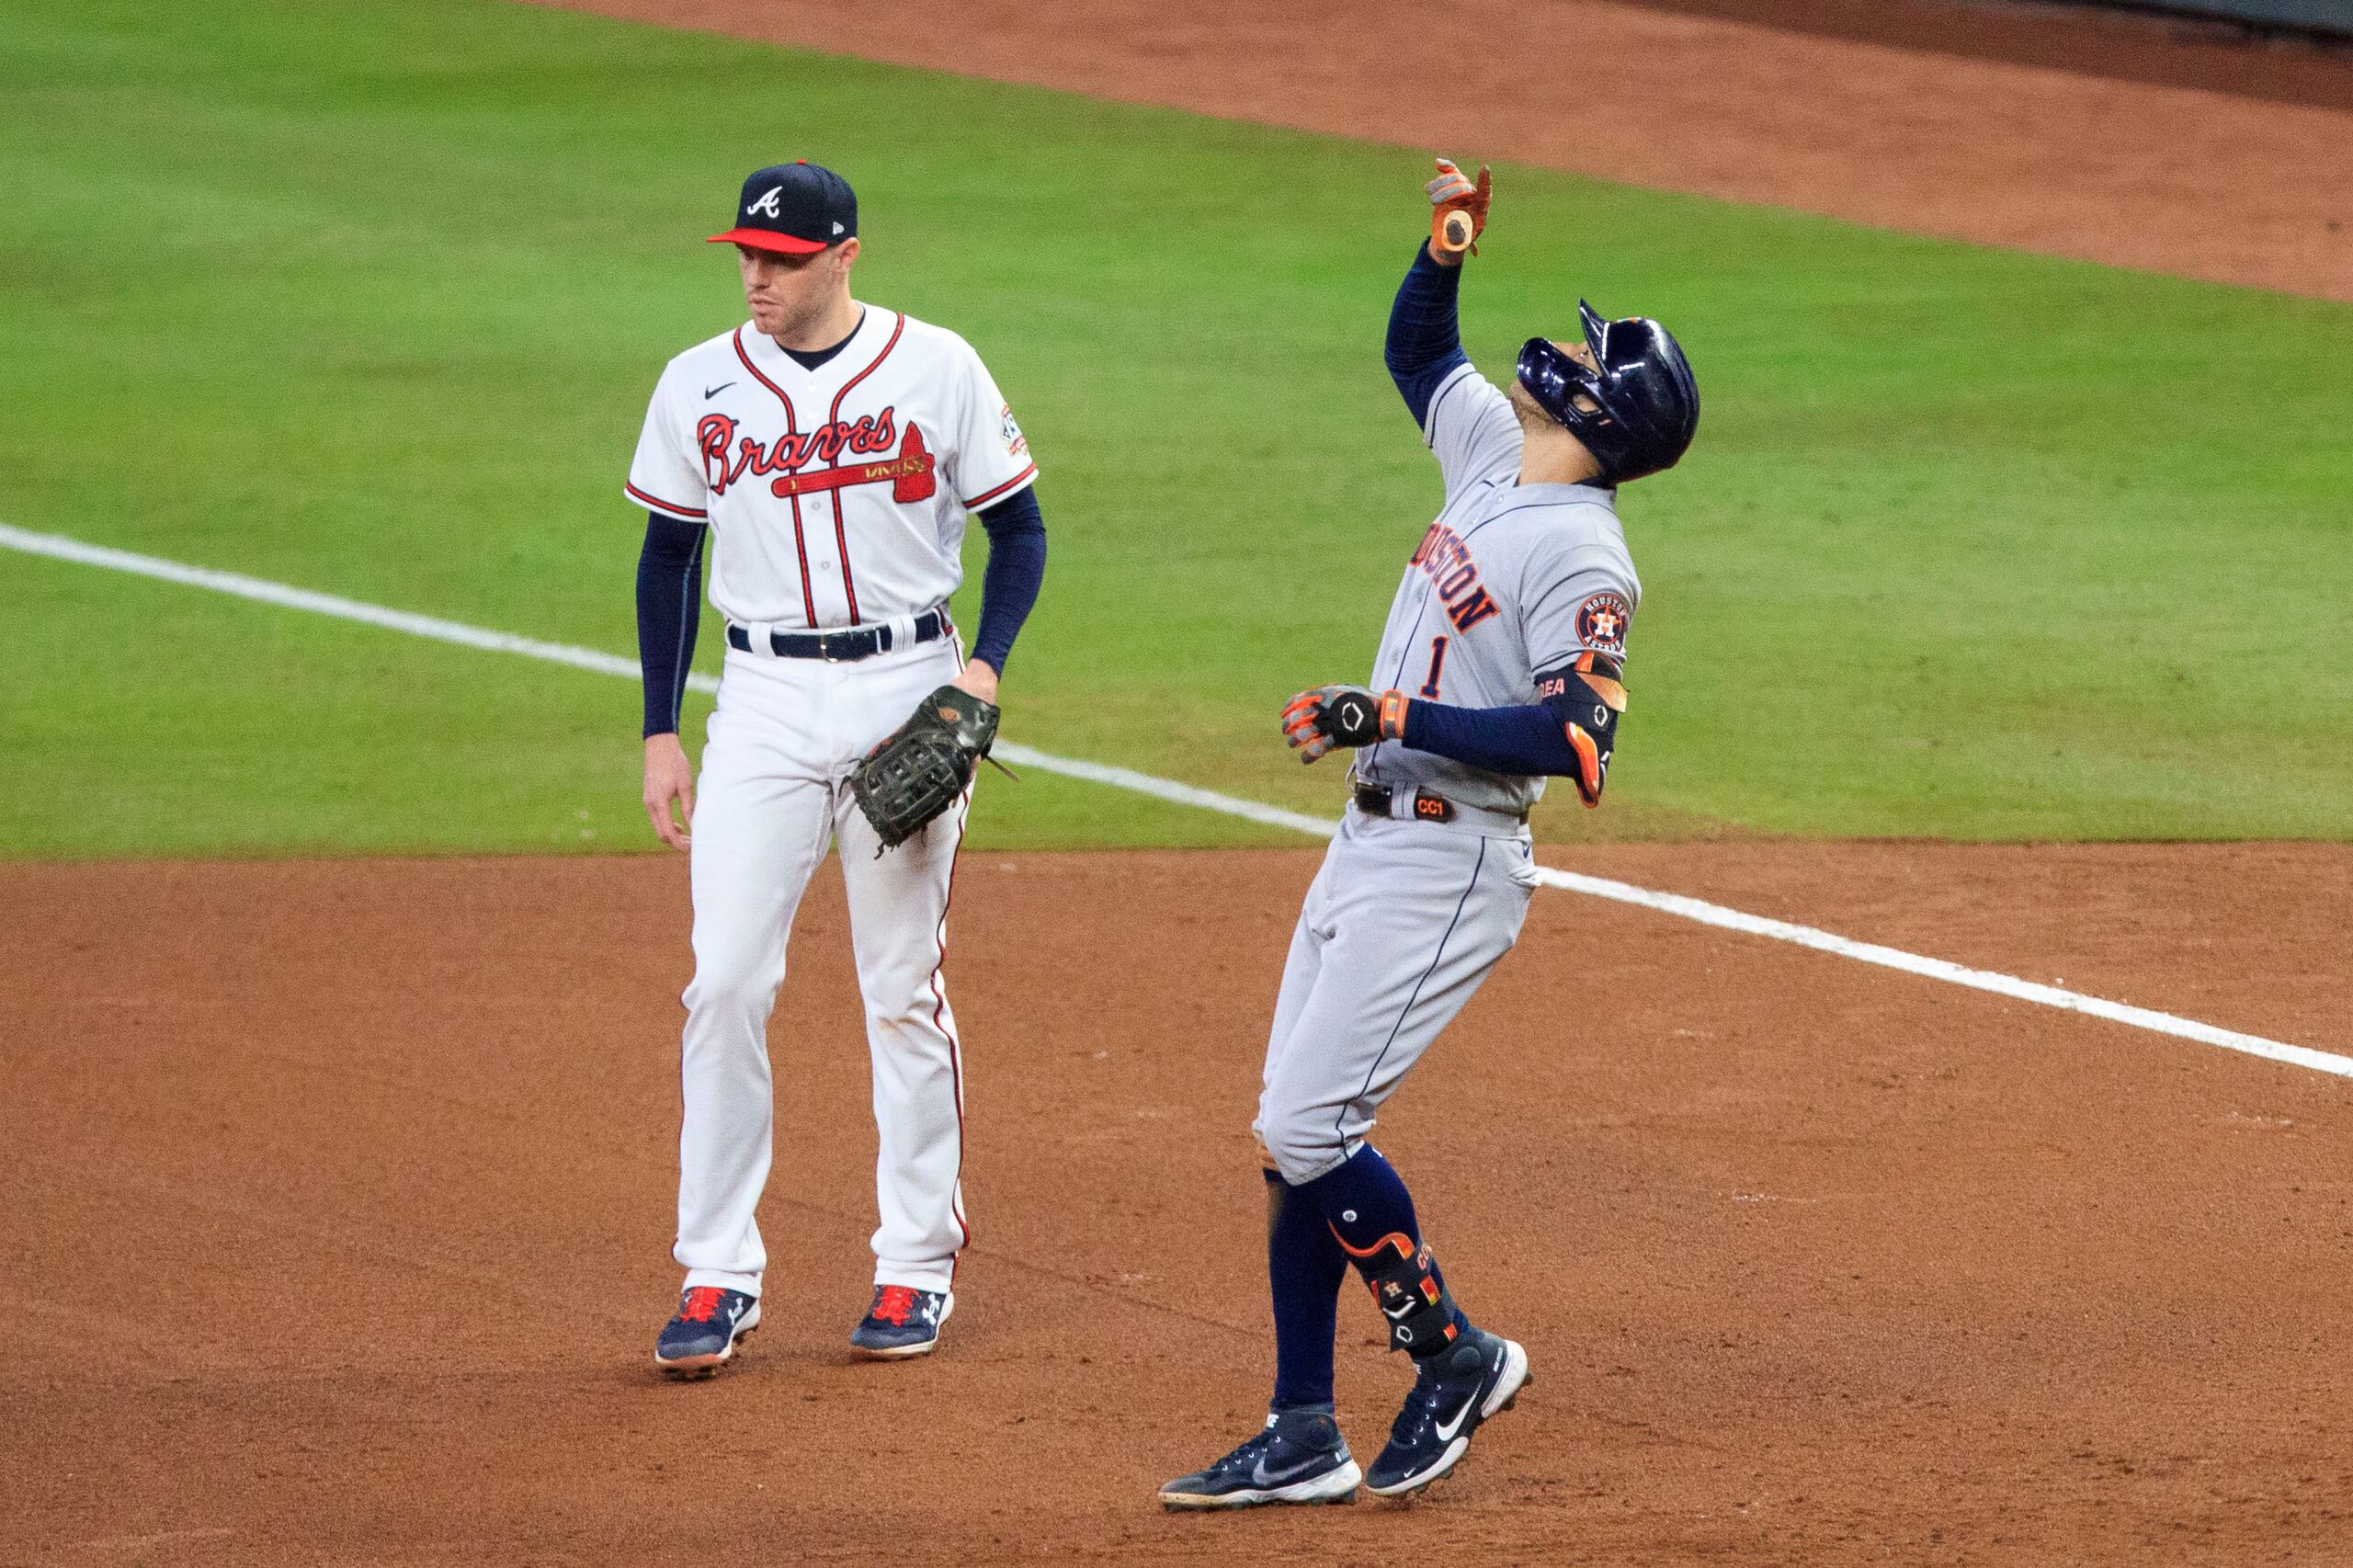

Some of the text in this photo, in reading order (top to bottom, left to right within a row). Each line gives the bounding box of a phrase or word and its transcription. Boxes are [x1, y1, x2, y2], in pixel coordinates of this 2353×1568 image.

[746, 186, 783, 218] A
[697, 406, 895, 496] Braves
[1585, 597, 1627, 617] HOUSTON
[1594, 612, 1617, 638] H
[1419, 634, 1449, 700] 1
[1417, 799, 1444, 815] CC1
